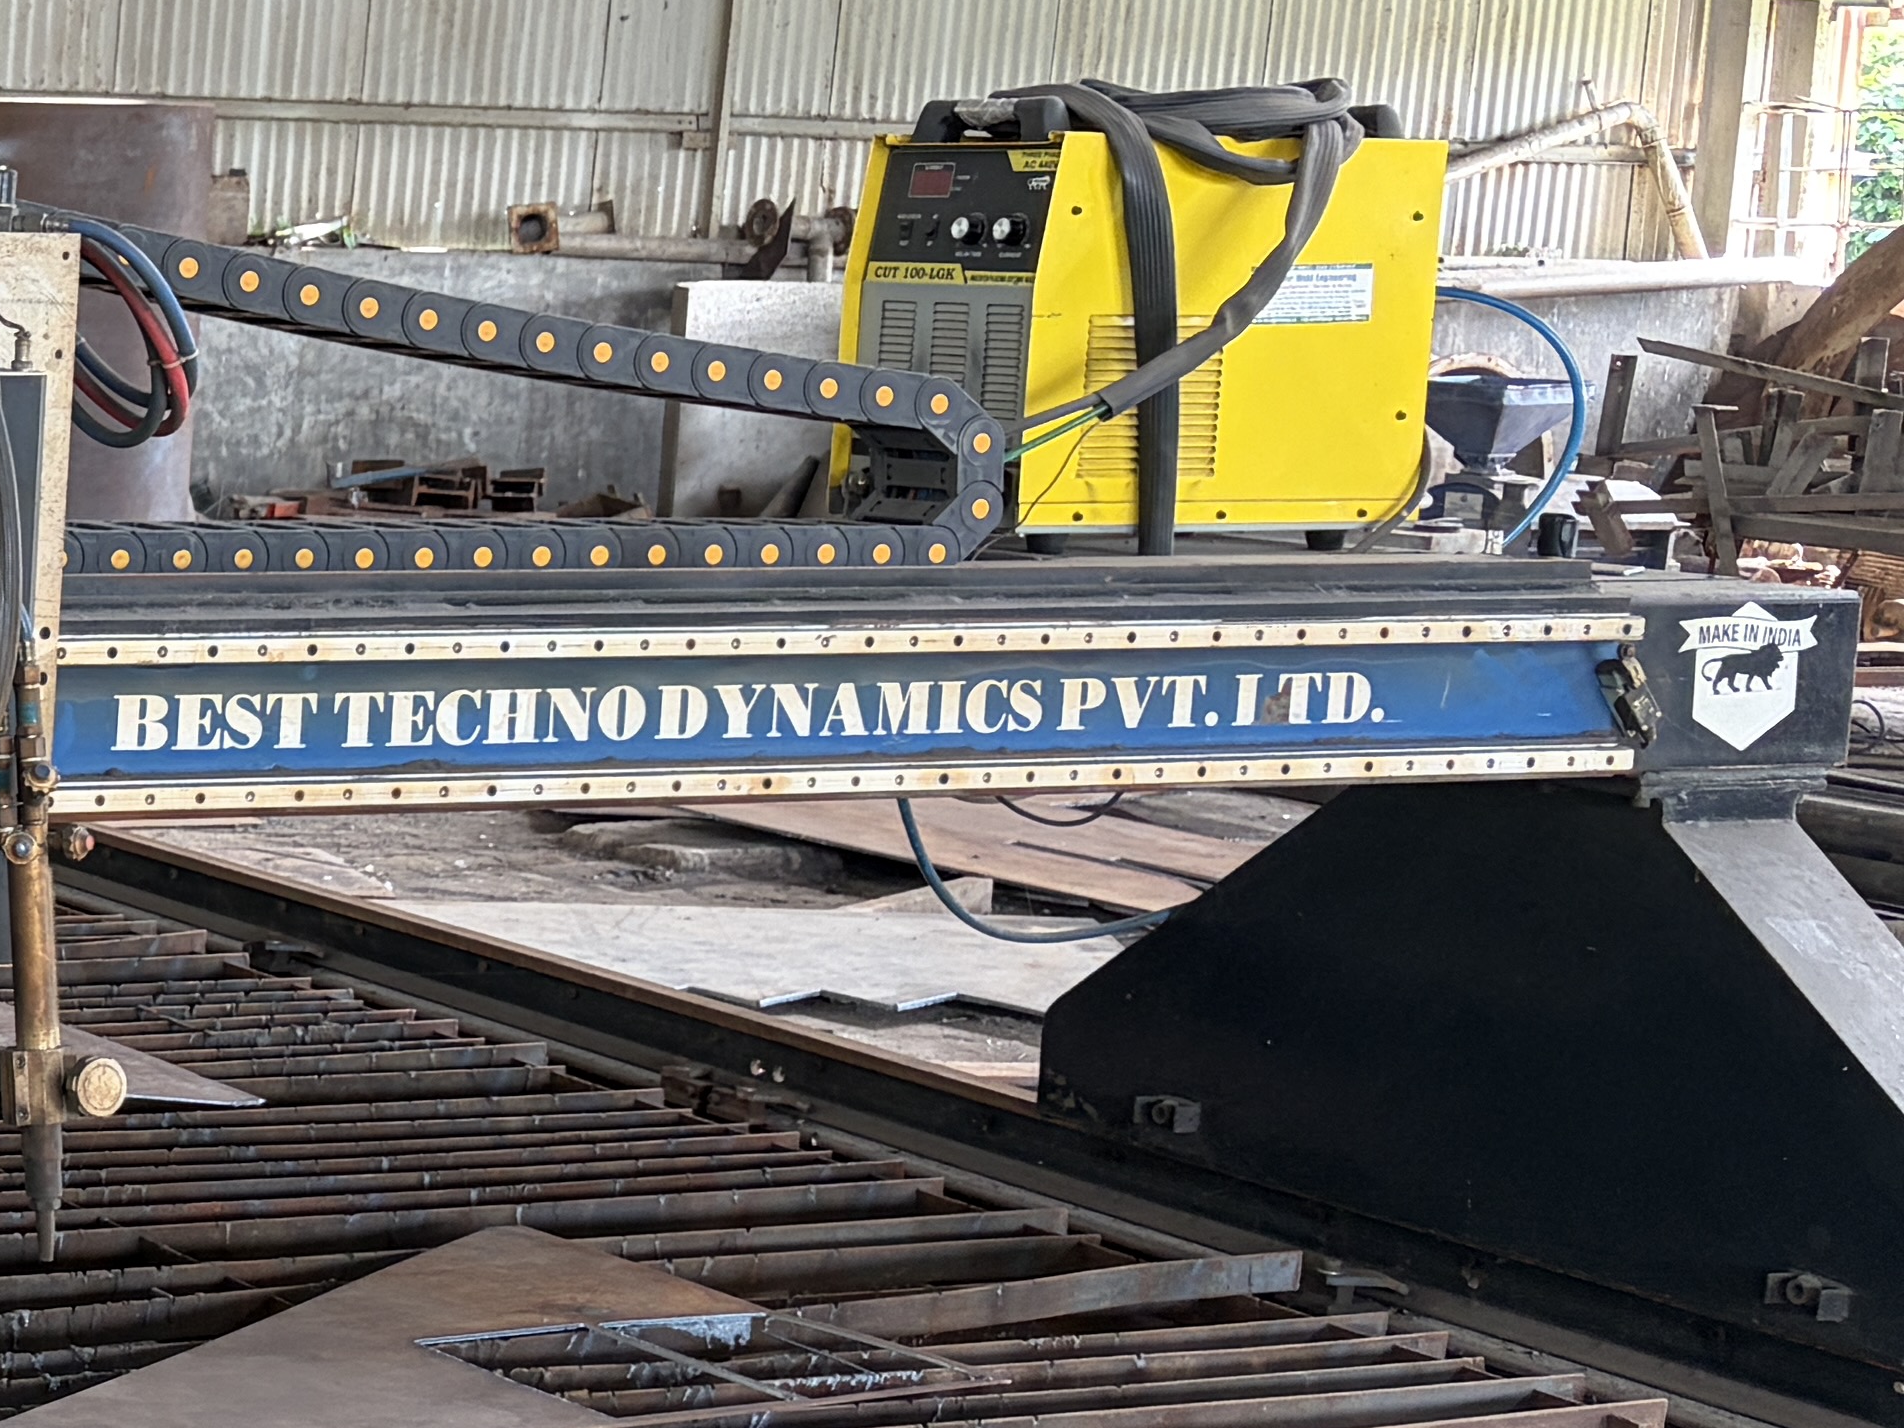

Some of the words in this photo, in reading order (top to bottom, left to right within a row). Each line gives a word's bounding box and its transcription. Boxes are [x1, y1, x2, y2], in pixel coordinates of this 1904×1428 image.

[874, 266, 899, 279] CUT
[903, 267, 956, 281] 100-LGK
[1699, 623, 1740, 644] MAKE
[1743, 624, 1759, 643] IN
[1762, 626, 1801, 647] INDIA
[111, 693, 318, 751] BEST
[1056, 676, 1219, 732] PVT.
